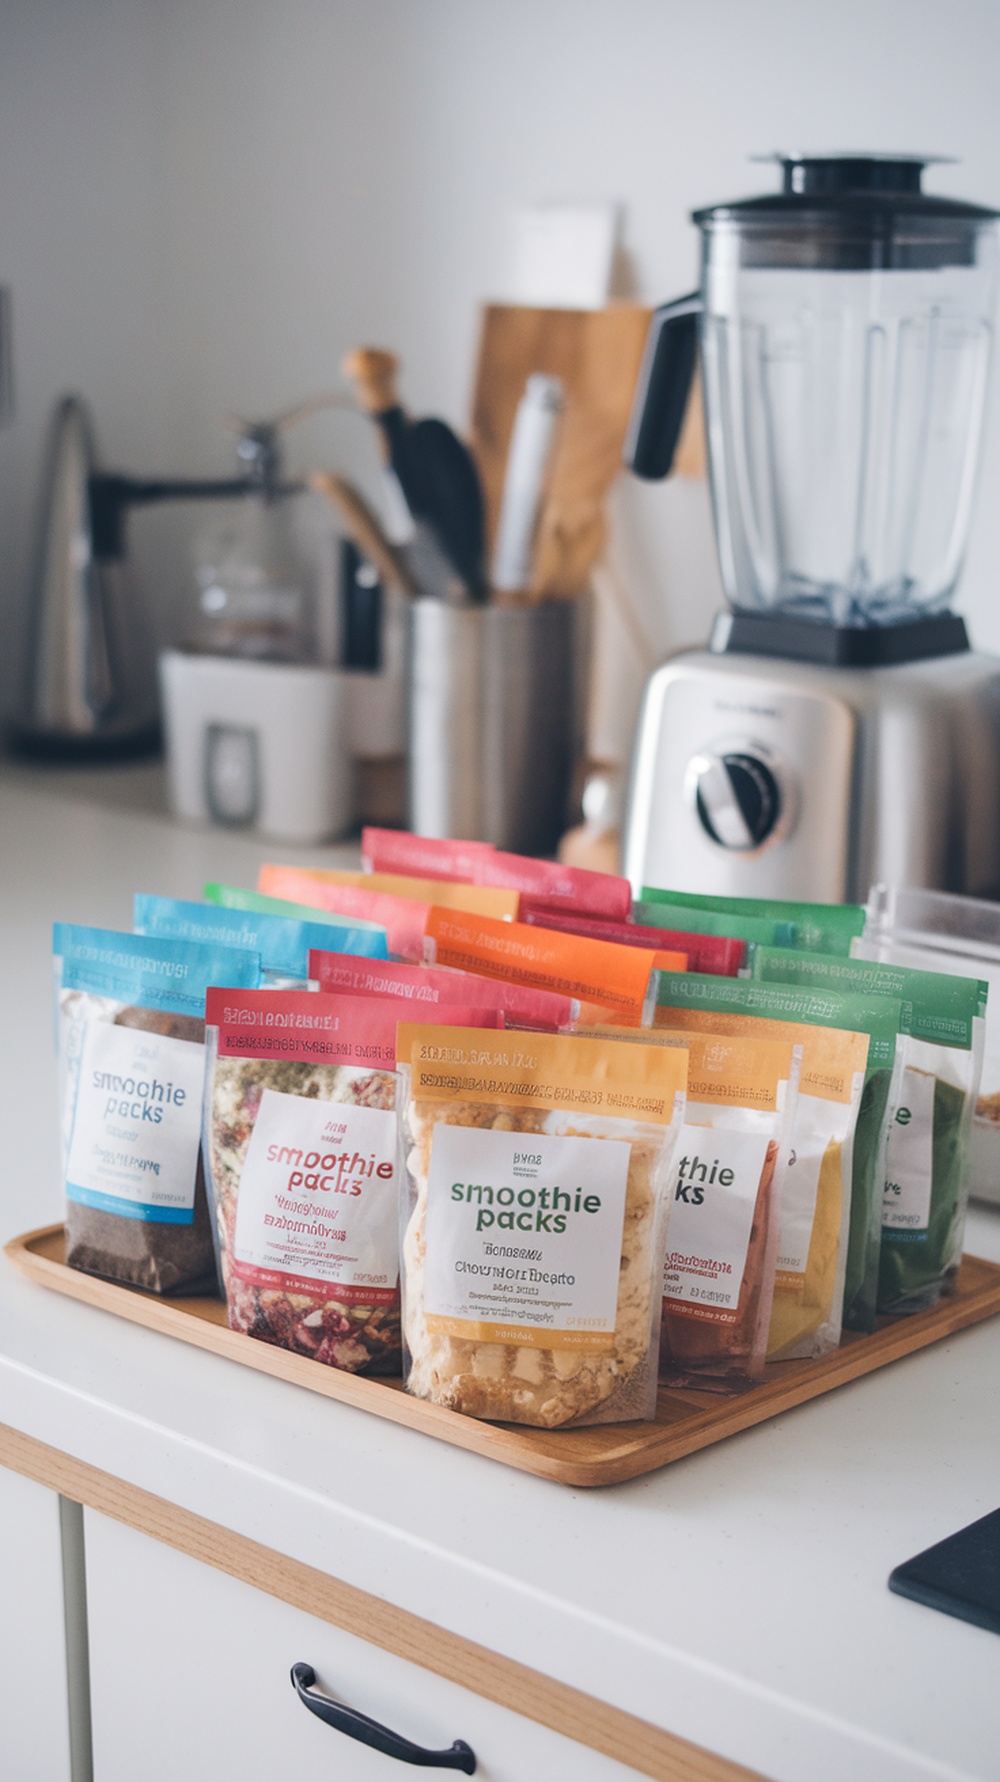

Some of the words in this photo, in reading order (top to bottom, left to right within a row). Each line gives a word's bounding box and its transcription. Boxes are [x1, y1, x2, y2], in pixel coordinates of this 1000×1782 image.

[266, 1143, 394, 1180] smoothie
[450, 1182, 602, 1214] smoothie
[475, 1208, 568, 1234] packs
